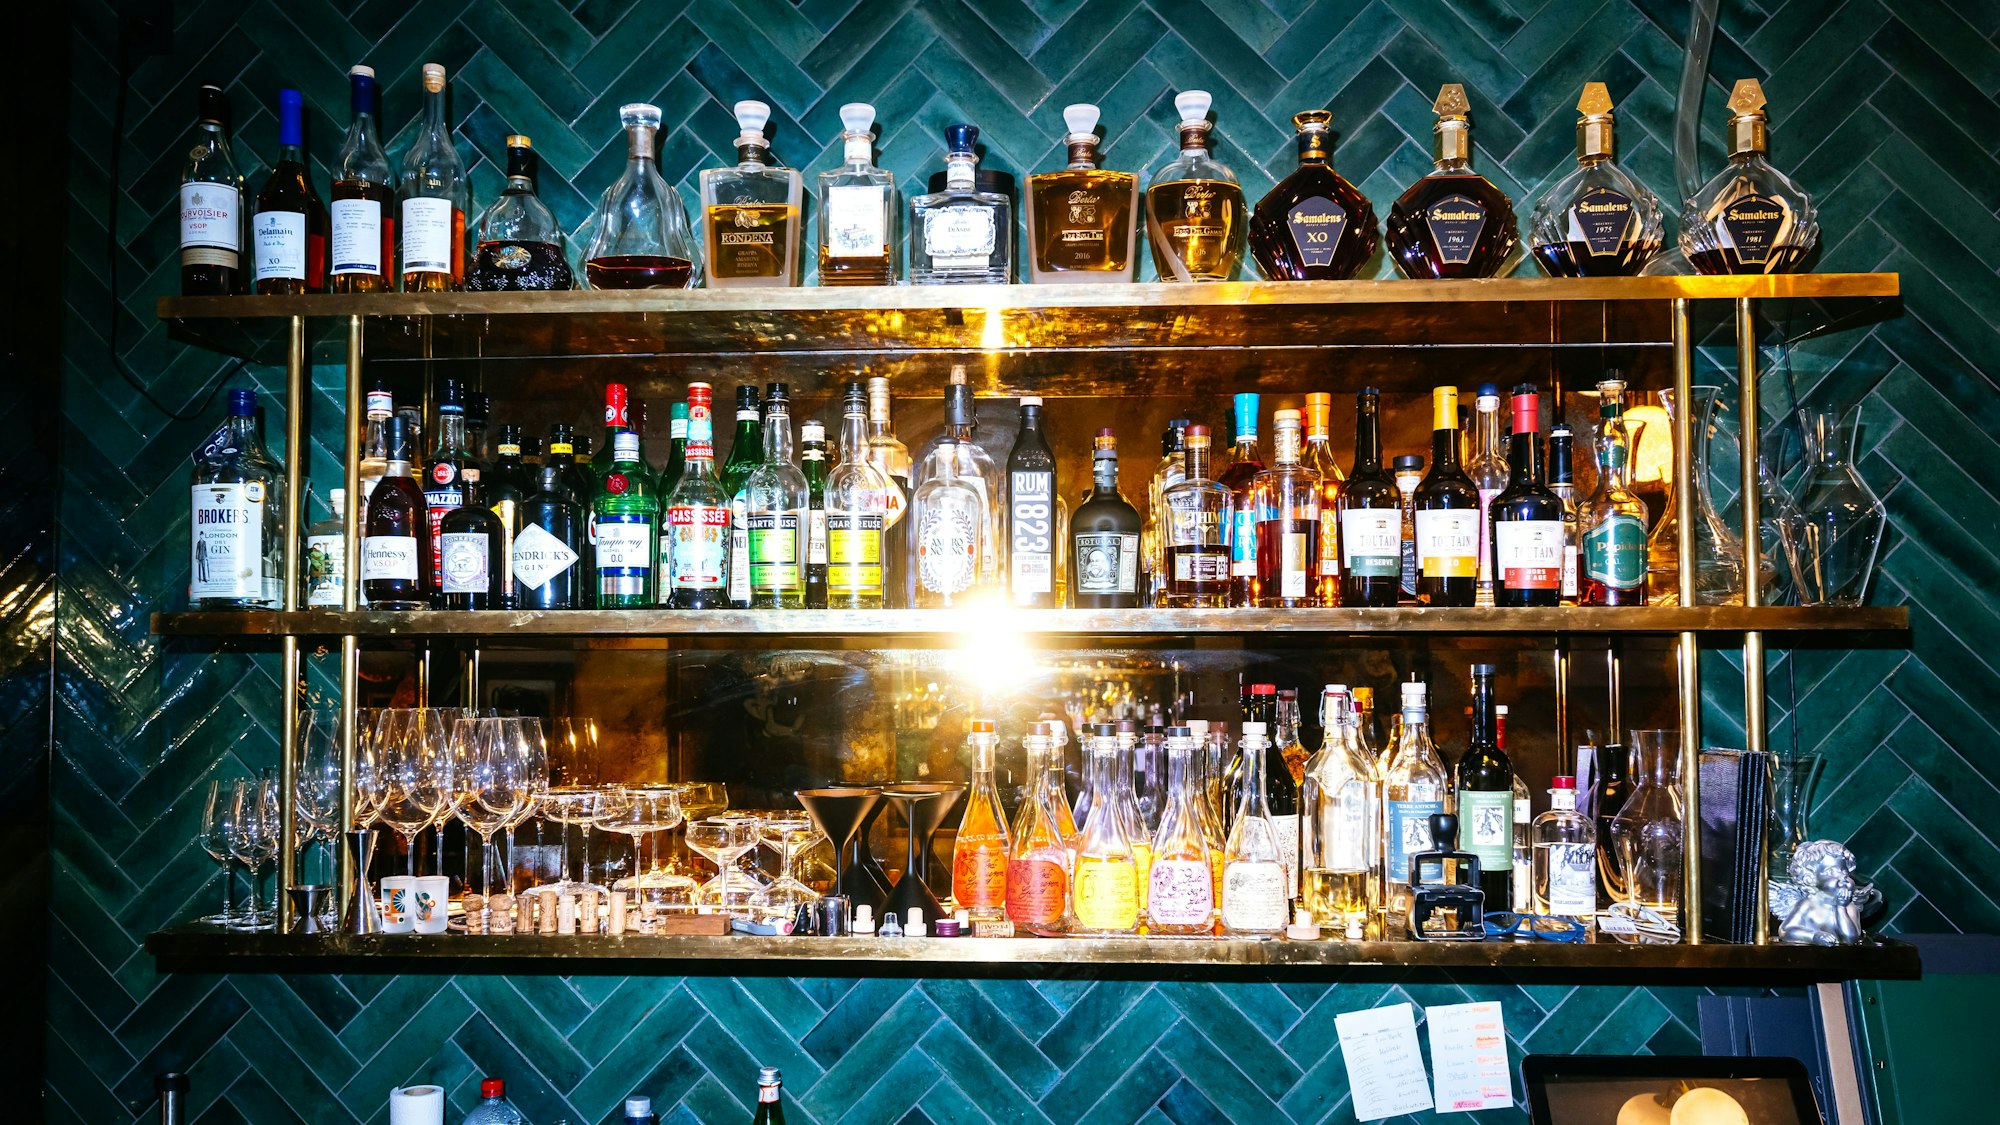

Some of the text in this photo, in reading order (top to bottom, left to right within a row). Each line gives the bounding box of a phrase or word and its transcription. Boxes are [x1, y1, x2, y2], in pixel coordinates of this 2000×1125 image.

[1579, 201, 1628, 213] Samalens
[1293, 211, 1341, 224] Samalens
[1431, 208, 1480, 220] Samalens
[1728, 209, 1779, 221] Samalens
[258, 228, 293, 236] Delamain
[1596, 226, 1612, 234] 1975
[721, 233, 773, 244] RONDENA
[1307, 232, 1328, 243] XO
[1746, 235, 1762, 243] 1981
[1074, 252, 1090, 260] 2016
[1015, 473, 1049, 493] RUM
[425, 493, 463, 505] MAZZOT
[672, 508, 726, 523] CASSSSÉE
[828, 520, 881, 529] CHARREUSE
[1015, 492, 1049, 552] 1823
[1360, 535, 1397, 546] TOUTAIN
[1432, 535, 1471, 547] TOTAIN
[211, 545, 231, 554] GIN
[367, 550, 408, 560] Hennessy
[611, 554, 623, 563] 0.0
